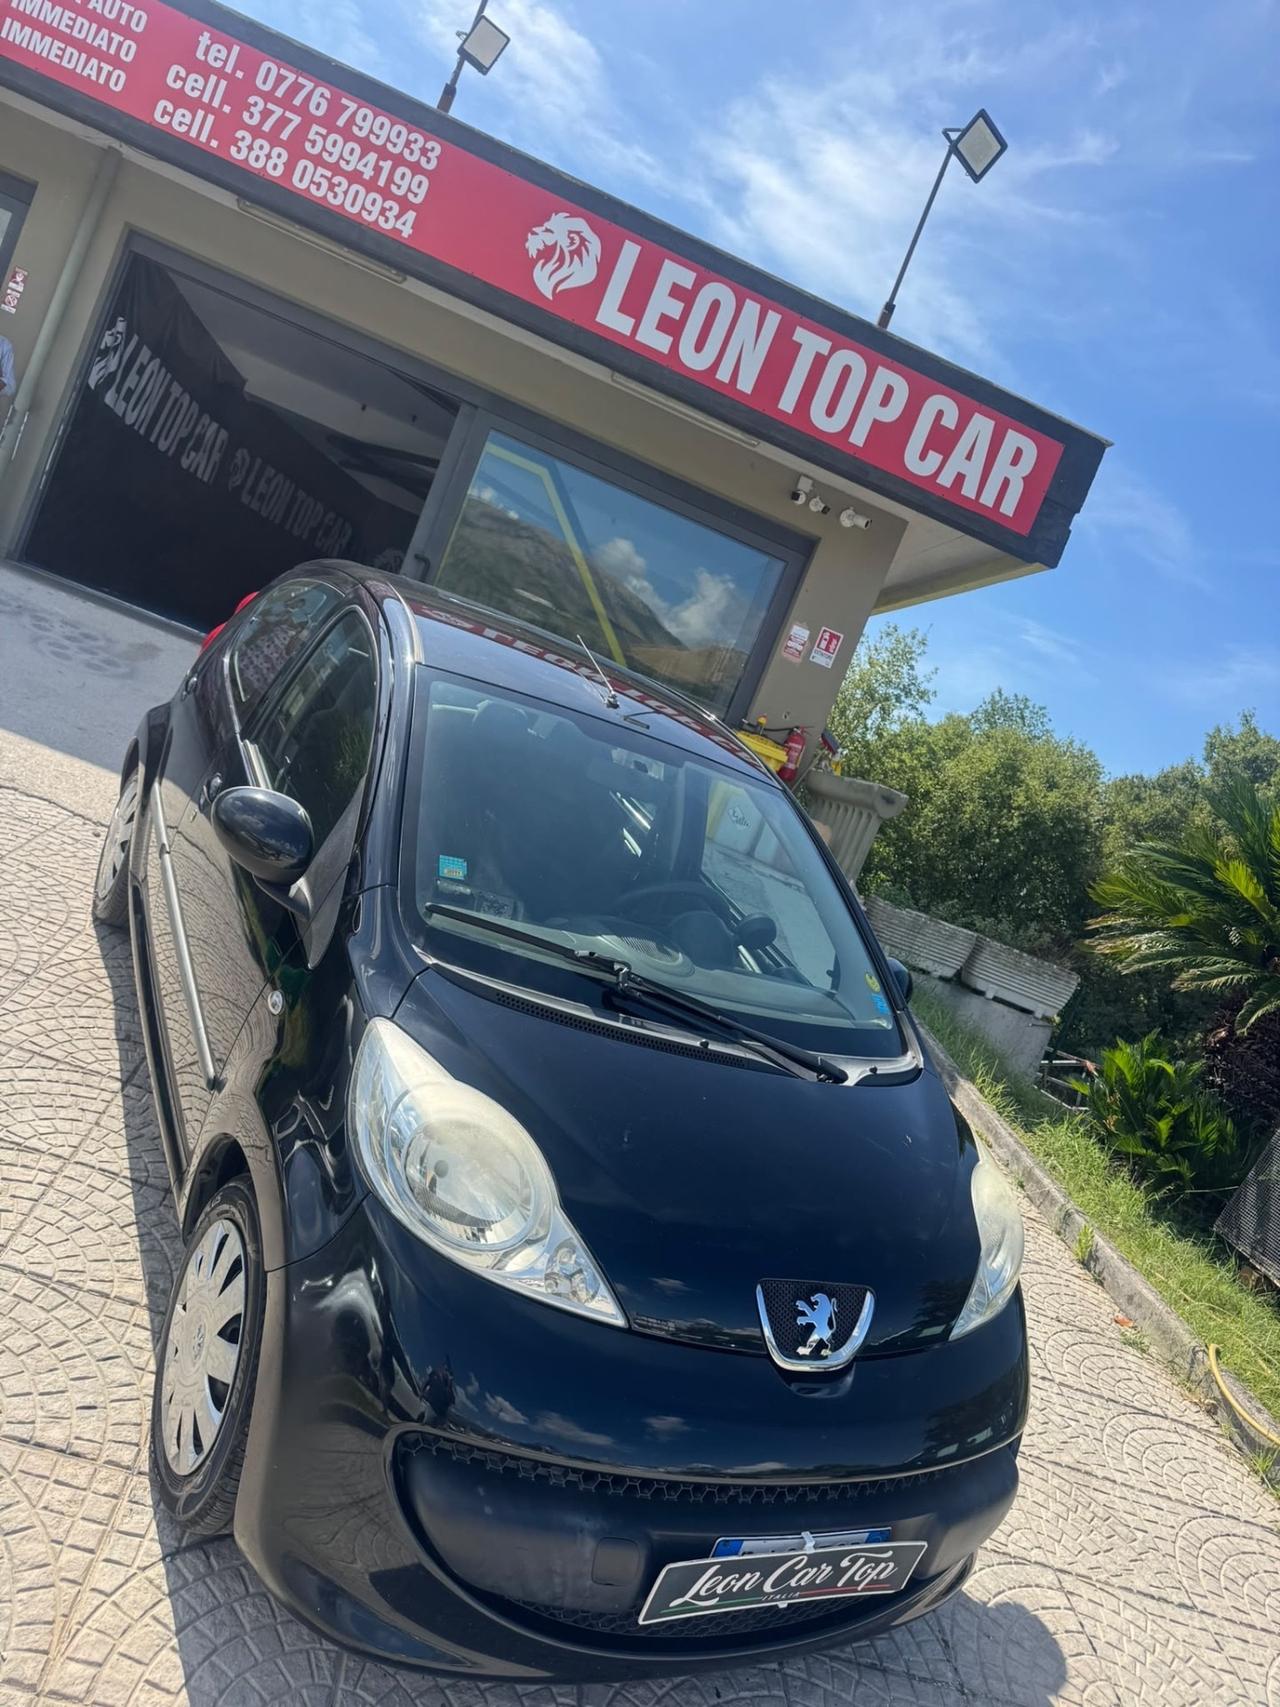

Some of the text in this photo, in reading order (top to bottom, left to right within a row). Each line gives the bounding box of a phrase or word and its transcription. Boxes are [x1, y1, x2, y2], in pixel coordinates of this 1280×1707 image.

[0, 17, 127, 92] IMMEDIATO
[87, 0, 148, 33] AUTO
[153, 99, 418, 238] cell. 388 0530934
[166, 64, 430, 204] cell. 377 5994199
[195, 31, 442, 170] tel. 0776 799933
[104, 333, 230, 485] LEON TOP CAR
[594, 239, 1038, 518] LEON TOP CAR
[240, 456, 354, 557] LEON TOP CAR
[669, 1550, 898, 1608] Leon Car Top
